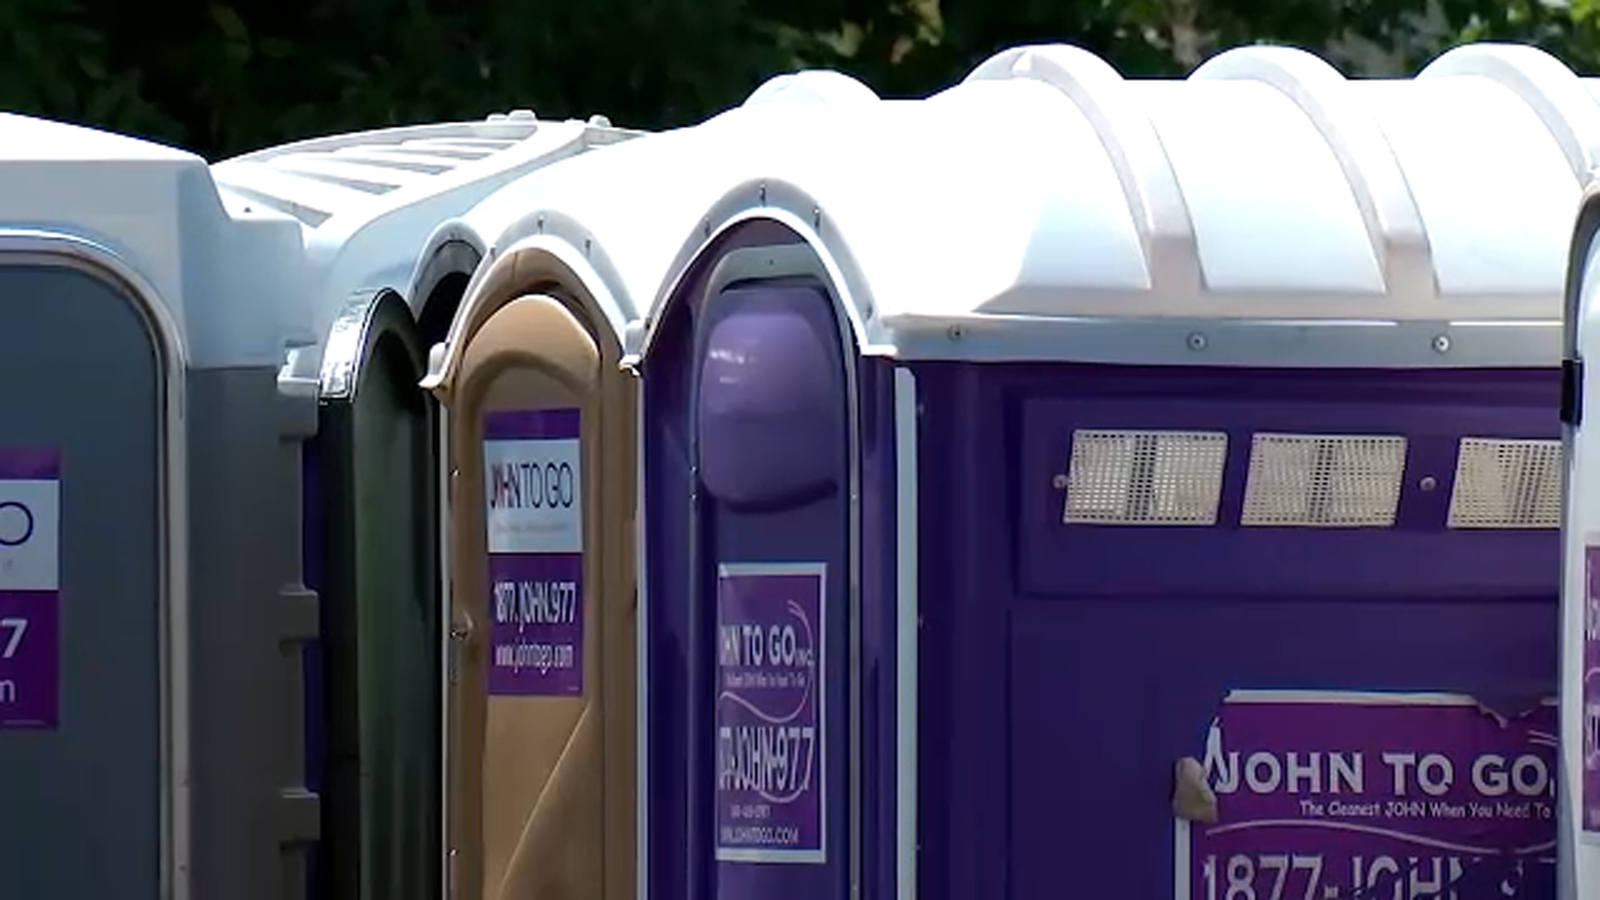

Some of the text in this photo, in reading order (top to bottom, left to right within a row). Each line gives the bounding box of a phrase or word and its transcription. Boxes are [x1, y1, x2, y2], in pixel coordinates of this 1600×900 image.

[521, 462, 543, 508] TO
[545, 462, 574, 508] GO
[742, 624, 763, 666] TO
[769, 624, 796, 666] GO
[1215, 751, 1364, 794] JOHN
[1383, 752, 1453, 796] TO
[1472, 754, 1548, 796] GO
[1300, 801, 1551, 818] The Cleanest JOHN When You Need To
